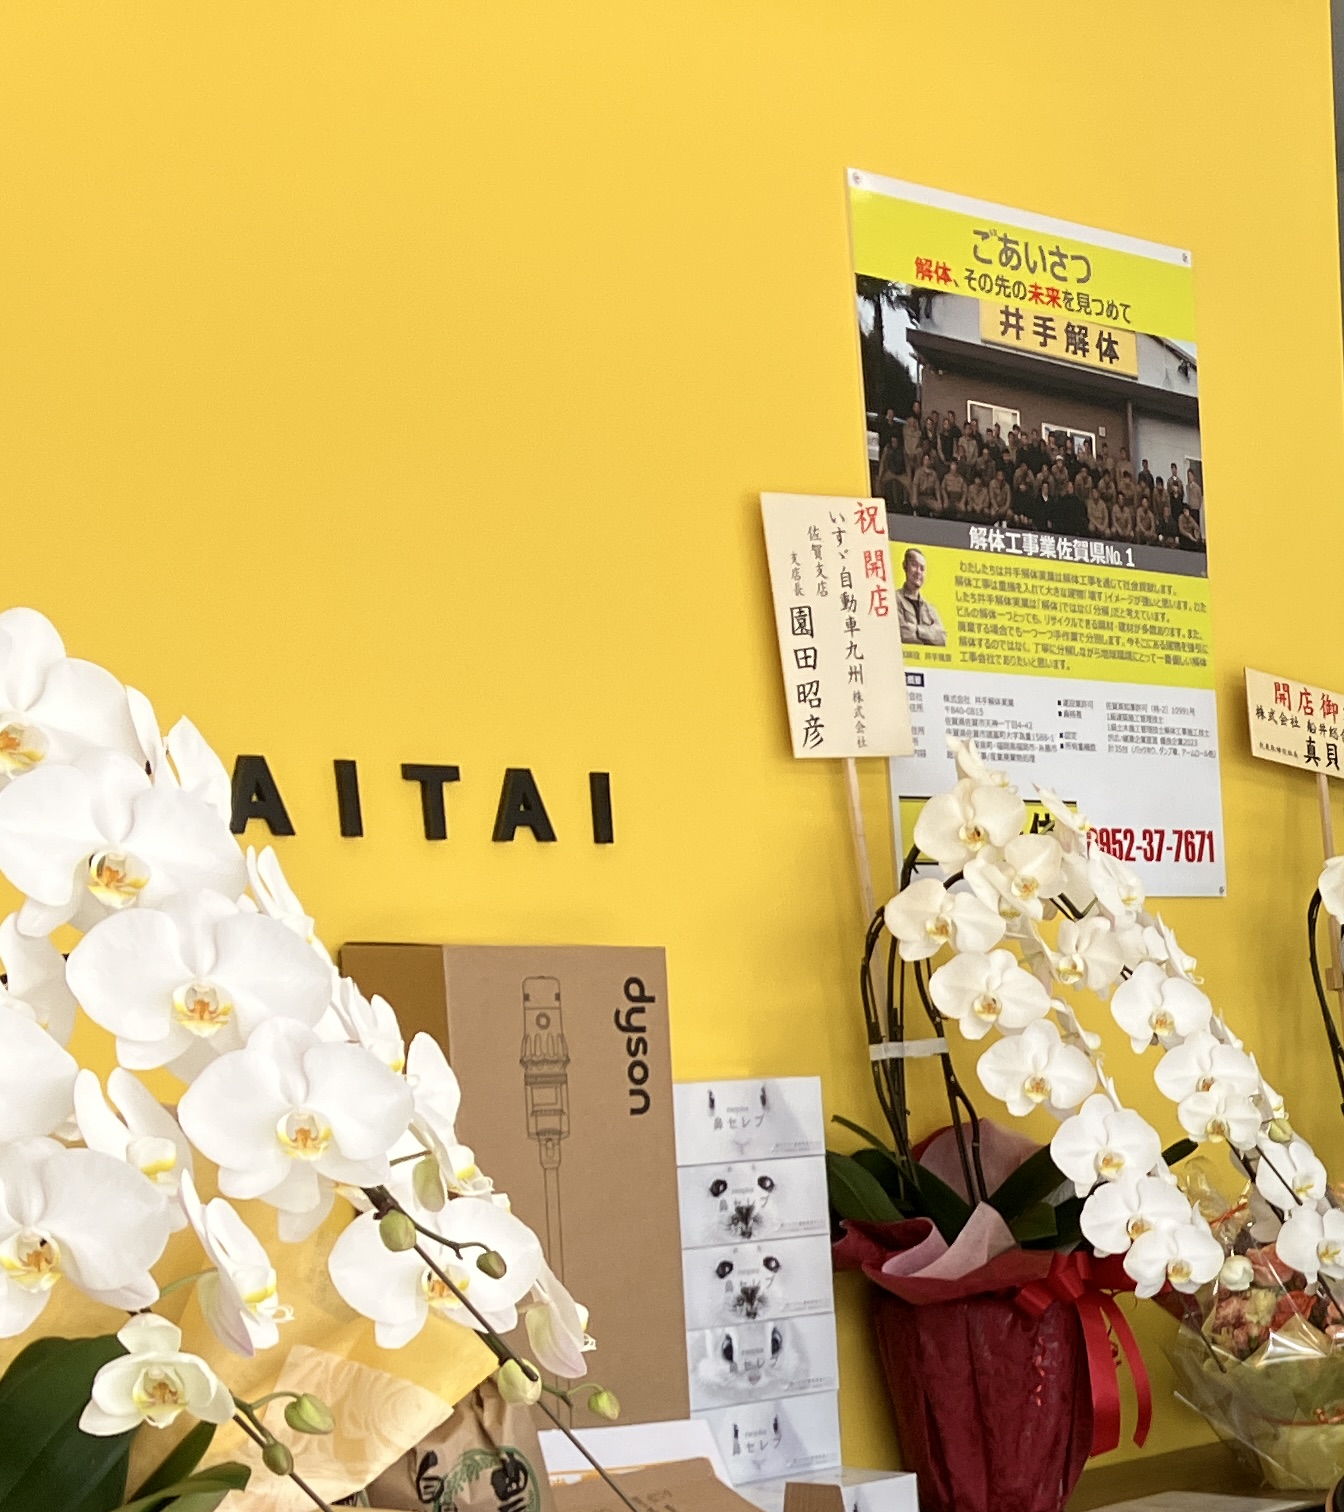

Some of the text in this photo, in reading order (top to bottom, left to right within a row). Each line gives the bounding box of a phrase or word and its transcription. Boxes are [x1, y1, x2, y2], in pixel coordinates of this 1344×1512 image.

[973, 229, 1092, 284] ごあいさつ
[914, 256, 1132, 324] 解体、その先の未来を見つめて
[999, 306, 1120, 364] 井手解体
[807, 525, 828, 598] 佐賀支店
[790, 552, 824, 749] 支店長 園田昭彦
[852, 690, 867, 749] 株式会社
[1256, 705, 1300, 728] 株式会社
[614, 976, 656, 1116] dyson
